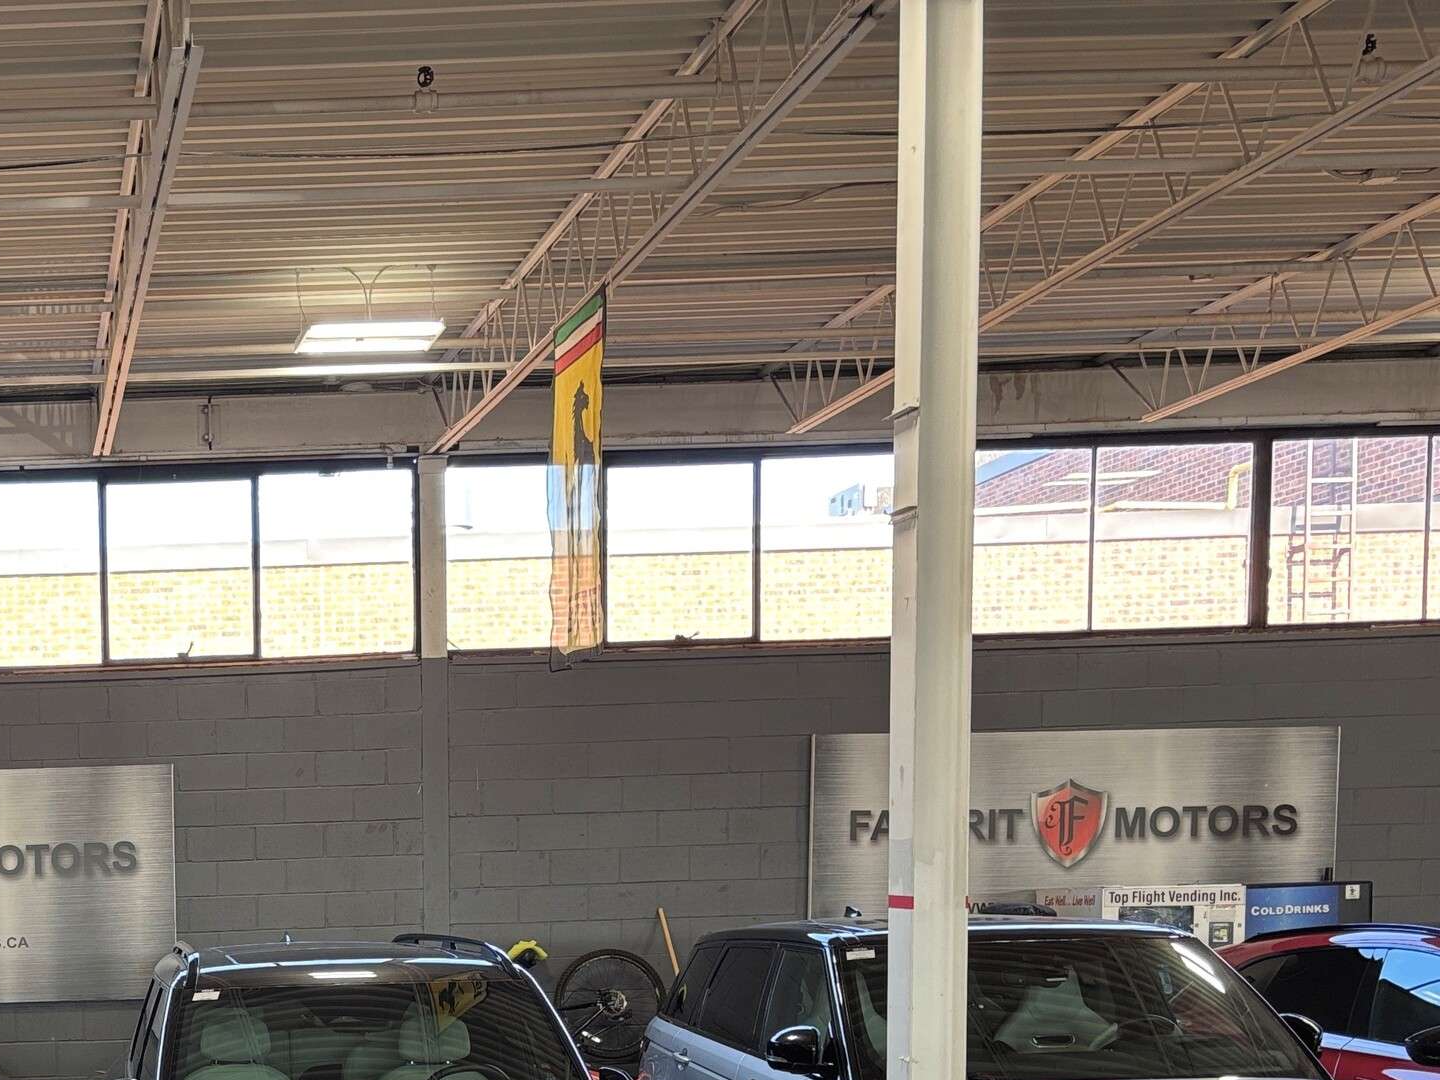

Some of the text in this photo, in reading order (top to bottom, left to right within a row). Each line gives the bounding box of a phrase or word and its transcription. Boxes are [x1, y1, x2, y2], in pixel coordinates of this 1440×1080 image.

[849, 808, 1024, 842] FARIT
[1115, 804, 1298, 840] MOTORS
[1108, 889, 1241, 906] Top Flight Vending Inc.
